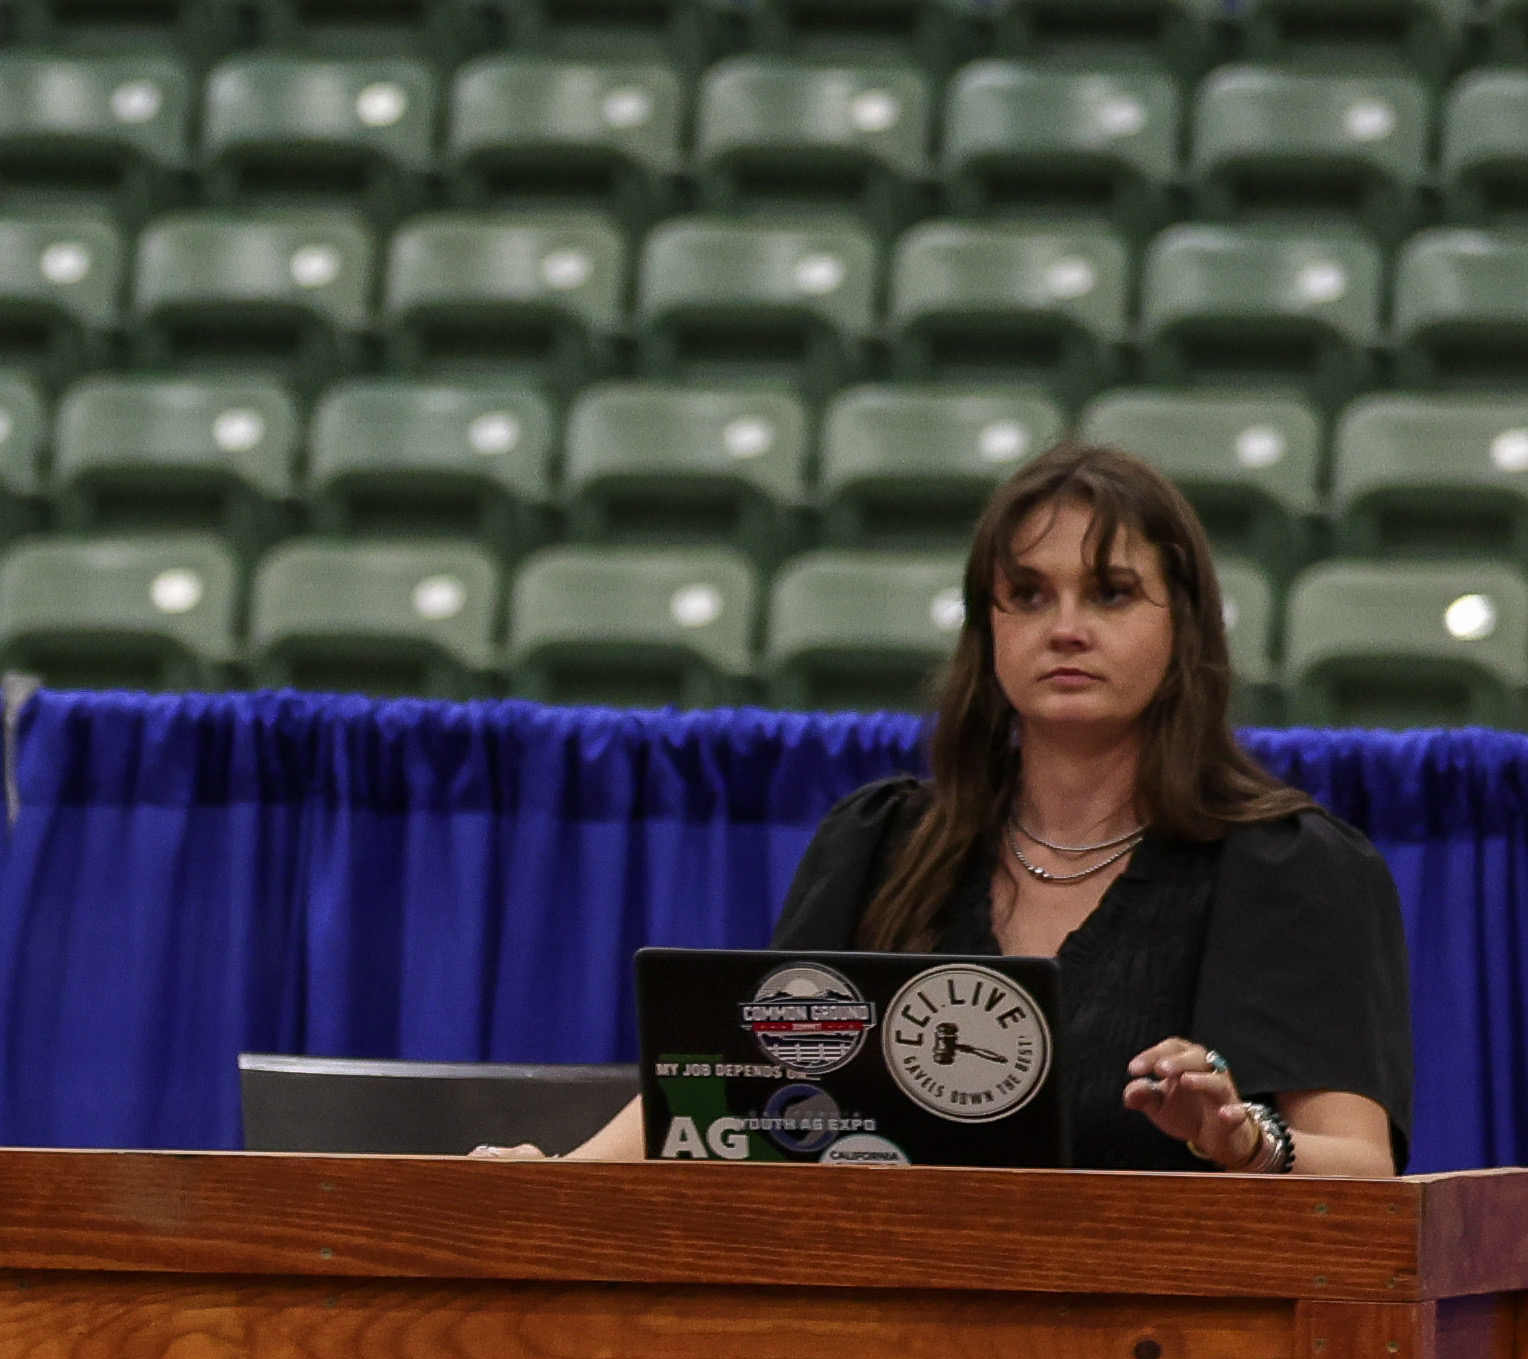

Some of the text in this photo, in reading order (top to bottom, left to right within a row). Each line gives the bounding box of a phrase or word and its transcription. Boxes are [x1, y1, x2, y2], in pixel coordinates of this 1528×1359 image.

[655, 1063, 679, 1077] MY
[682, 1063, 712, 1077] JOB
[714, 1064, 783, 1079] DEPENDS
[827, 1118, 877, 1132] EXPO
[660, 1115, 750, 1160] AG
